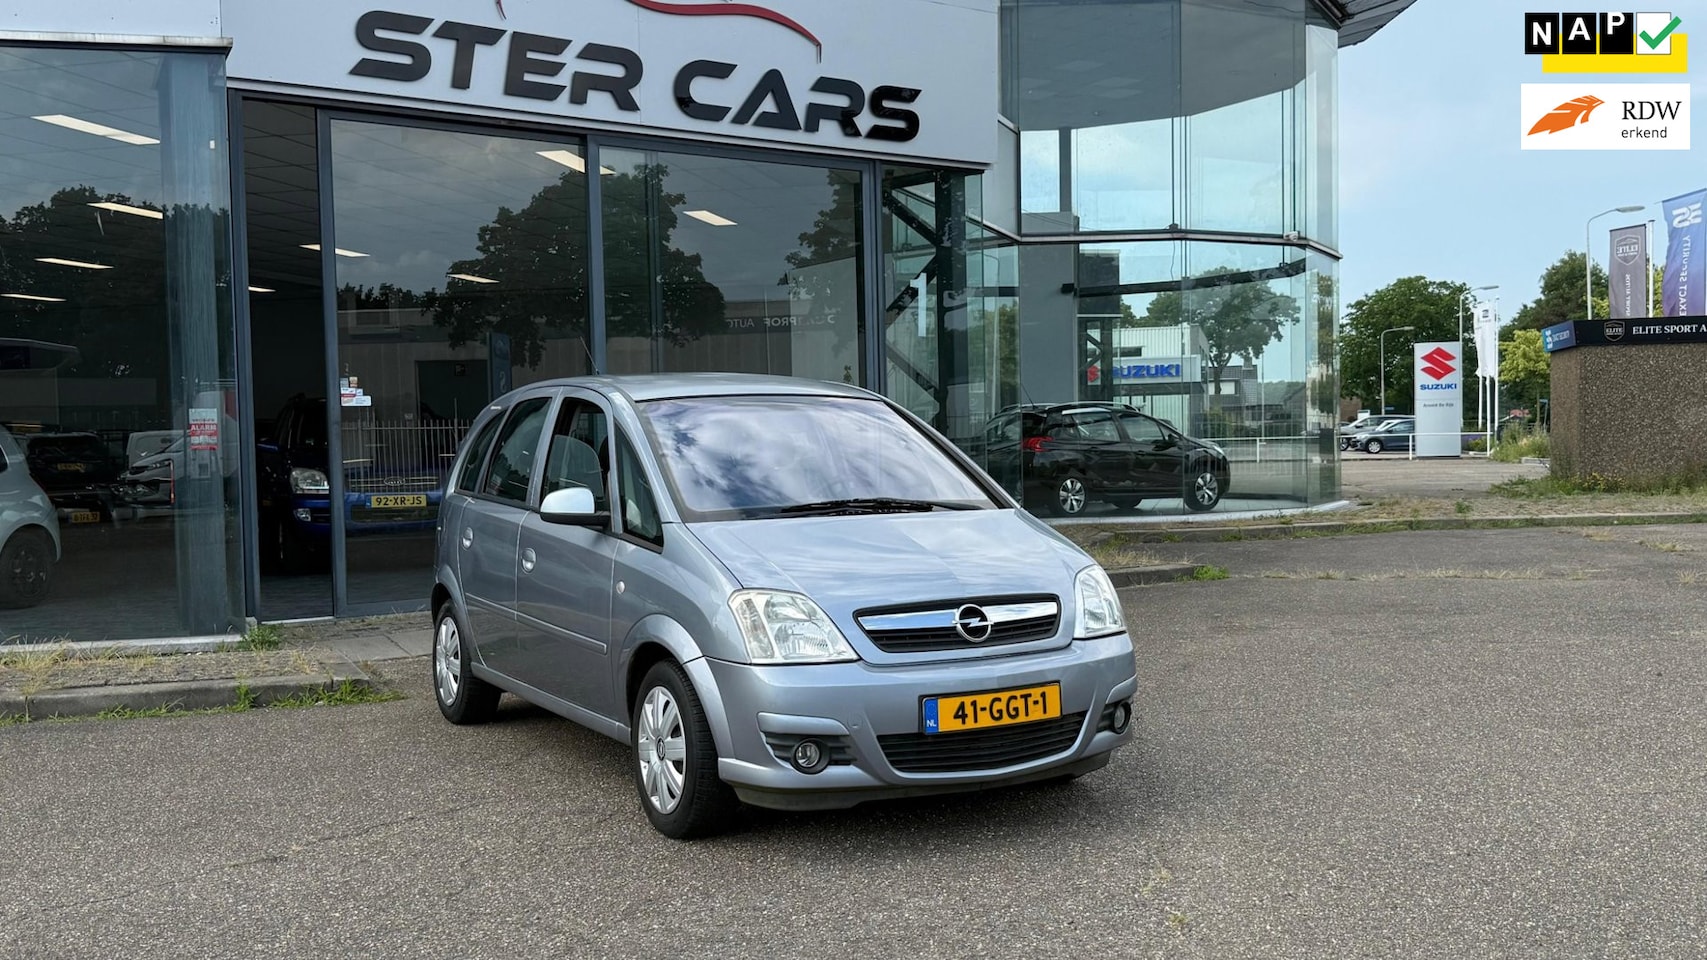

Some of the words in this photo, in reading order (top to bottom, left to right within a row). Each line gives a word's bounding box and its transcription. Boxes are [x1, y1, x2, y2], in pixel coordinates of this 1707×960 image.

[349, 10, 644, 112] STER
[673, 59, 923, 142] CARS
[1632, 324, 1662, 335] ELITE
[1663, 323, 1697, 334] SPORT
[1419, 383, 1457, 391] SUZUKI
[375, 496, 422, 506] 92-XR-JS
[953, 691, 1048, 725] 41-GGT-1
[926, 719, 937, 728] NL
